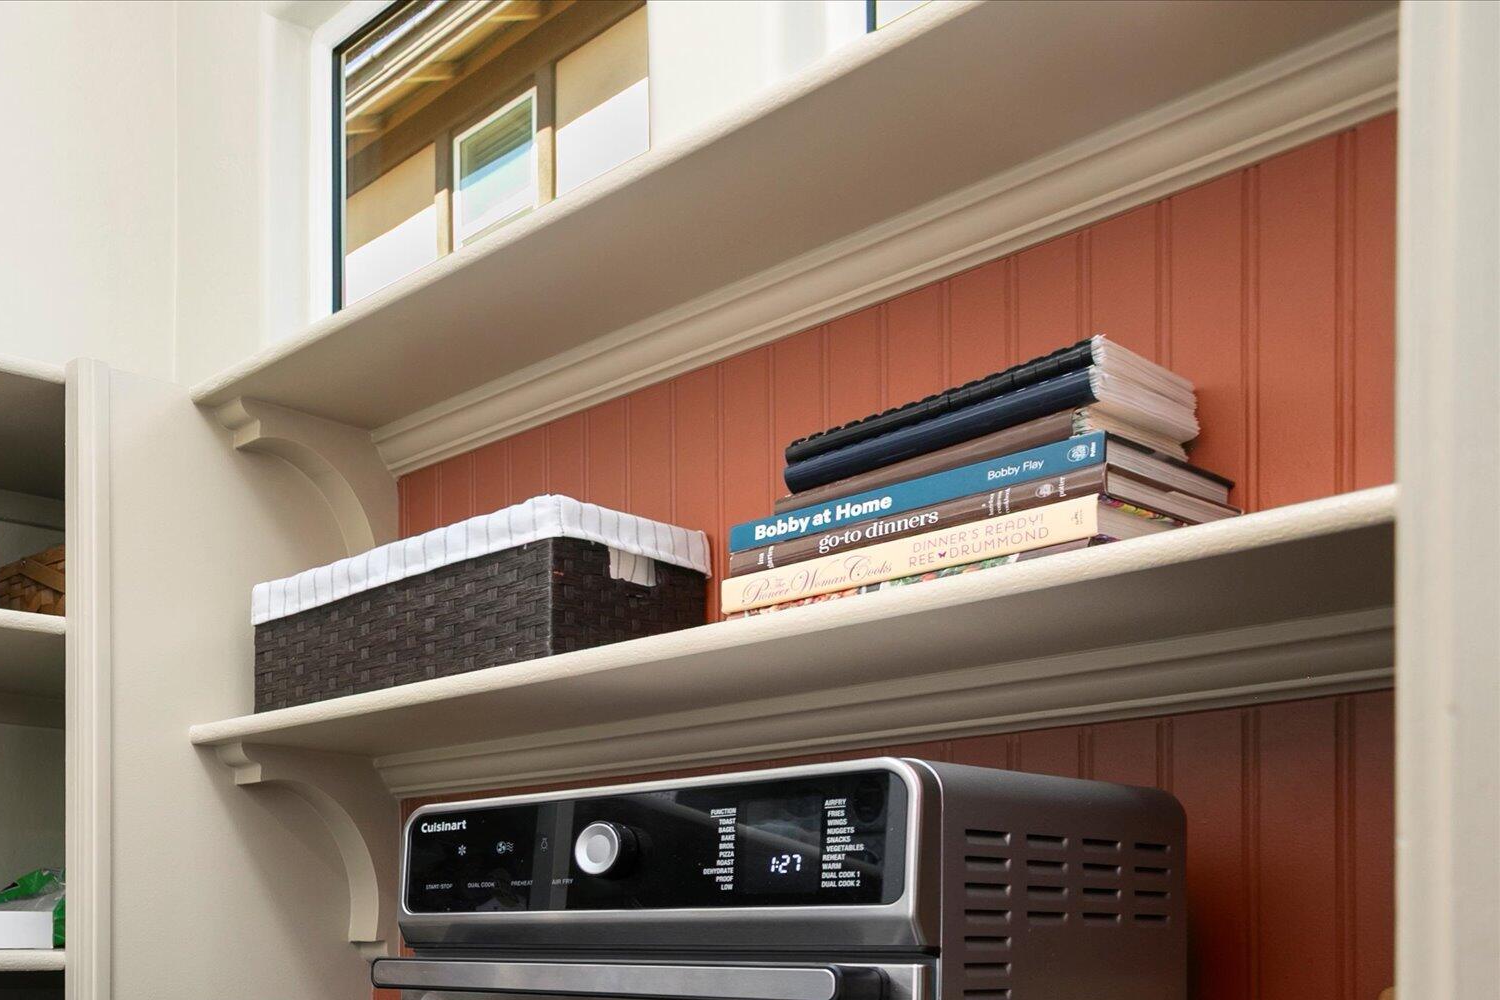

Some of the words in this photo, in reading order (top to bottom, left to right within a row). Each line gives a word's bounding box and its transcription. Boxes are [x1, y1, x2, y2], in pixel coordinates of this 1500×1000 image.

[987, 465, 1020, 481] Bobby
[1022, 459, 1045, 473] Flay
[754, 515, 811, 541] Bobby
[811, 510, 832, 527] at
[835, 495, 893, 521] Home
[818, 529, 862, 554] go-to
[865, 510, 939, 540] dinners
[912, 528, 979, 554] DINNER'S
[985, 513, 1044, 536] READY!
[909, 551, 935, 568] REE
[949, 526, 1049, 559] DRUMMOND
[742, 577, 790, 605] Pioneer
[790, 561, 847, 593] Woman
[843, 555, 892, 582] Cooks
[710, 807, 737, 815] FUNCTION
[421, 819, 467, 834] Cuisinart
[827, 818, 847, 826] WINGS
[826, 844, 864, 852] VEGETABLES
[703, 867, 734, 875] DEHYDRATE
[770, 854, 802, 874] 1:27
[821, 880, 837, 888] DUAL
